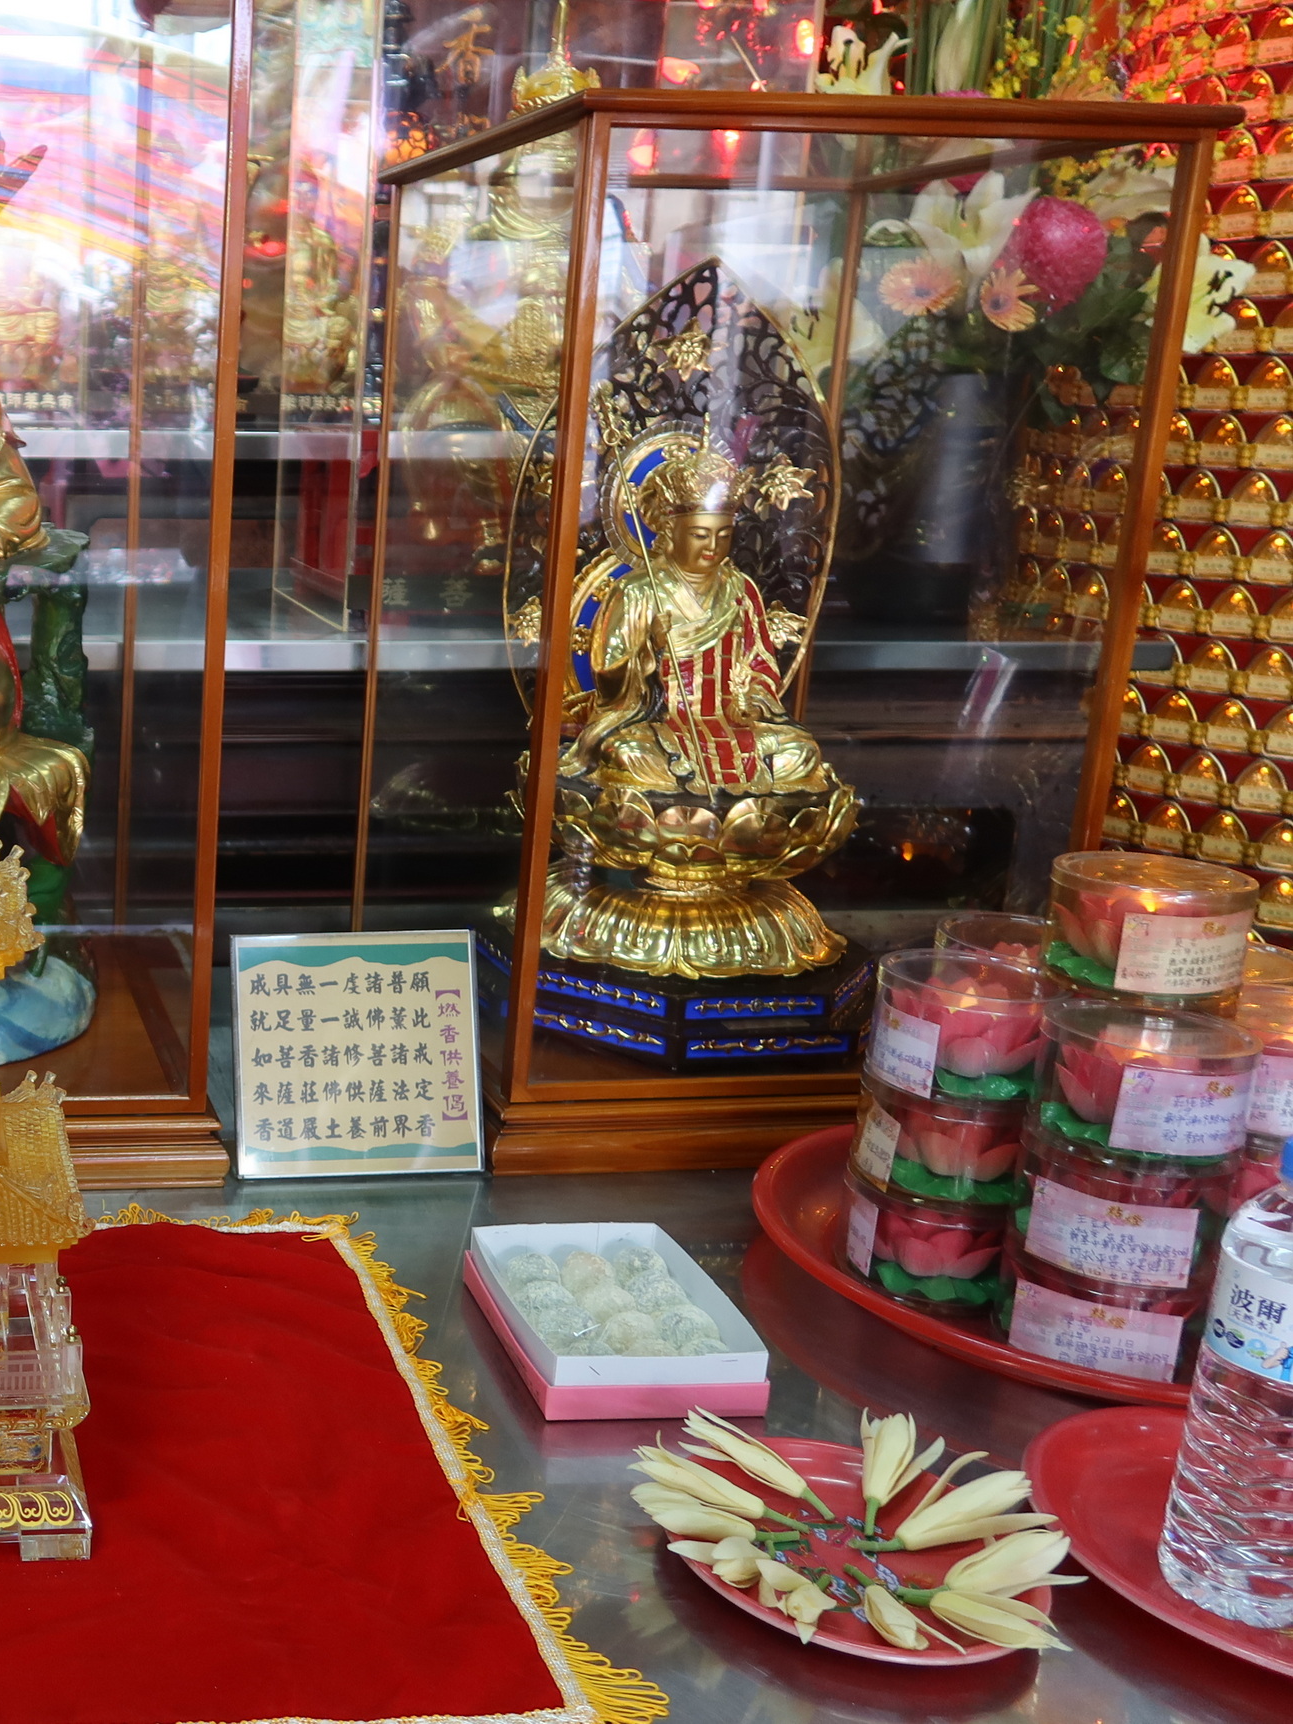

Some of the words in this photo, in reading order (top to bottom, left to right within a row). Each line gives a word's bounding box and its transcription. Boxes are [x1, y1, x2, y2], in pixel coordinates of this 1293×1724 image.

[249, 973, 275, 1142] 成就如來香
[273, 973, 297, 1141] 具足菩薩道
[319, 980, 343, 1140] 一一諸佛土
[364, 972, 390, 1138] 諸佛菩薩前
[387, 971, 413, 1138] 普薰諸法界
[409, 971, 436, 1137] 願此戒定香
[1229, 1284, 1287, 1324] 波爾
